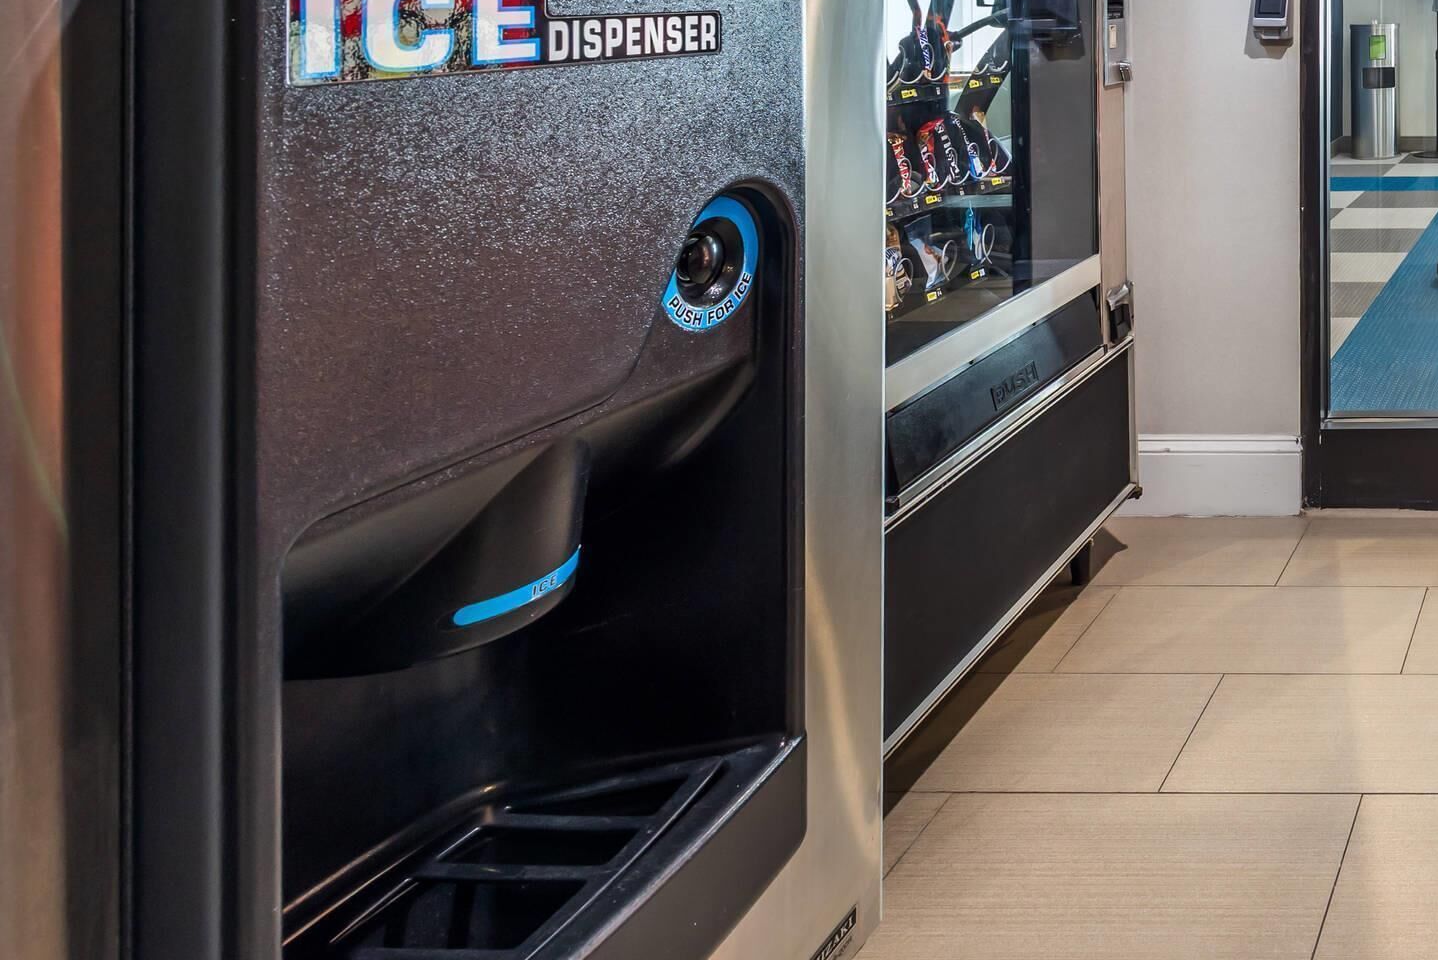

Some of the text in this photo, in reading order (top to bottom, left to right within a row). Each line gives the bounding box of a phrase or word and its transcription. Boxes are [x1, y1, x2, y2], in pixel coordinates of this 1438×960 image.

[548, 14, 717, 63] DISPENSER
[668, 271, 752, 326] PUSH FOR ICE
[532, 574, 557, 596] ICE
